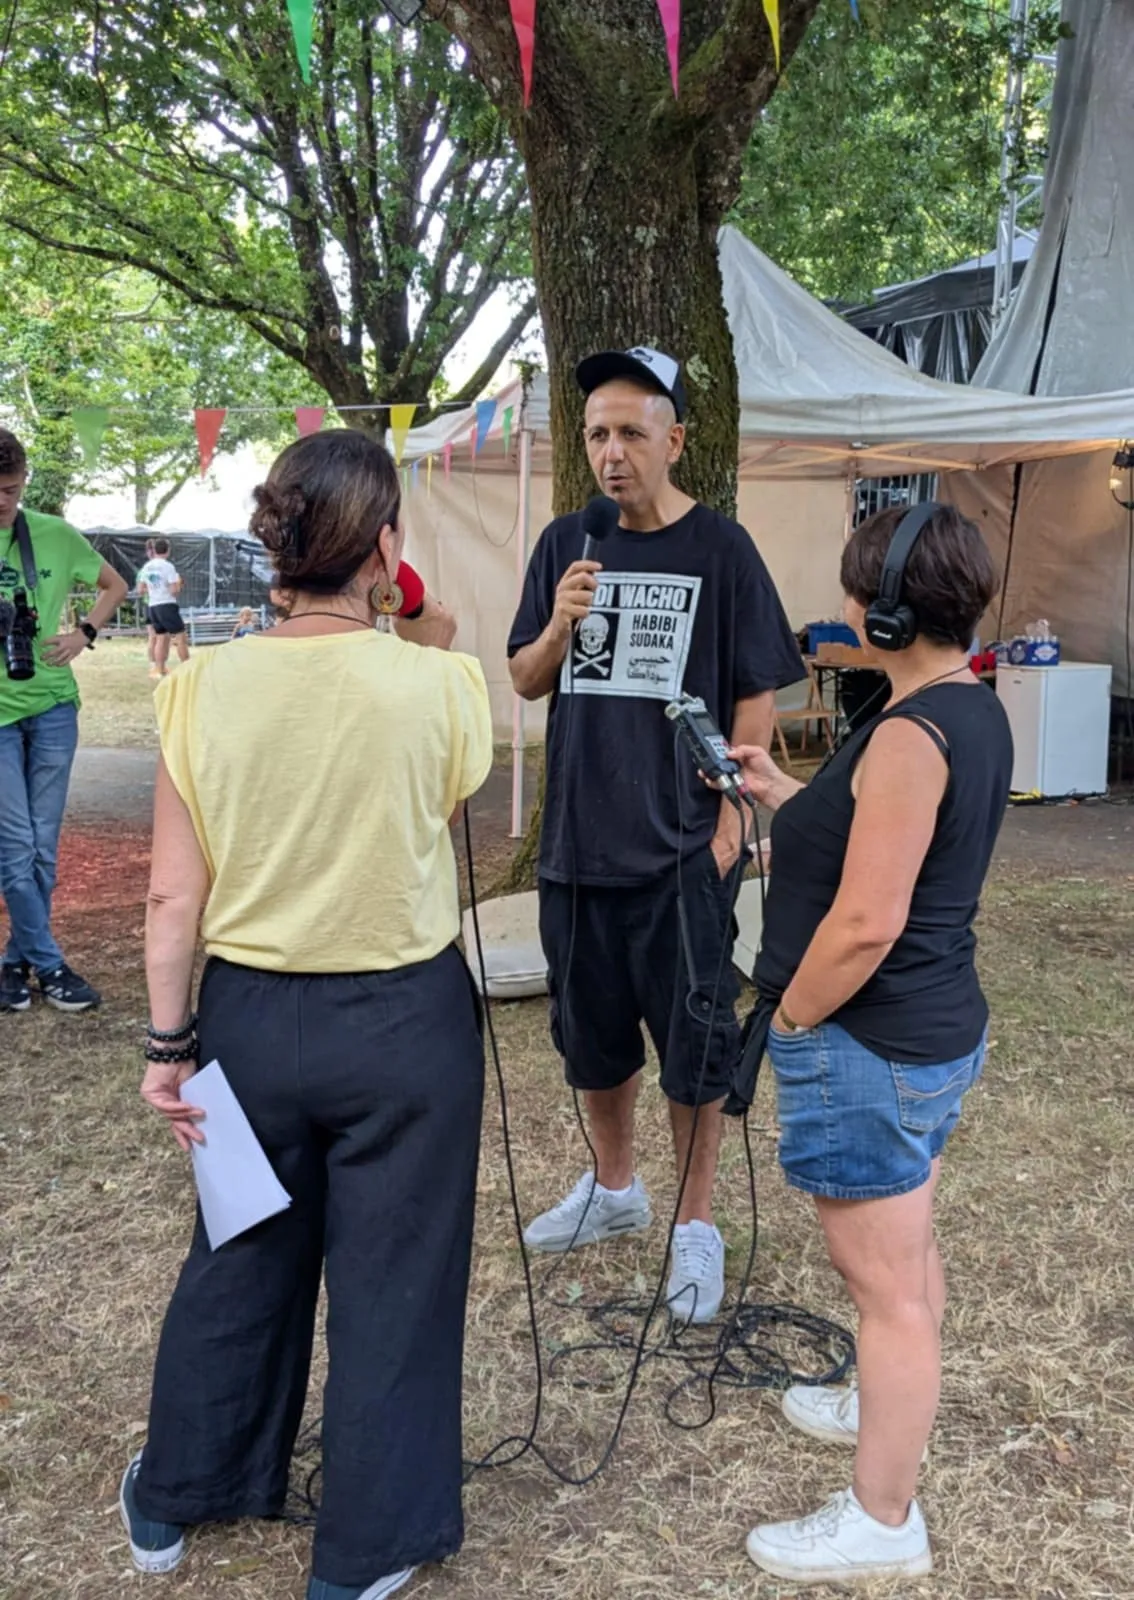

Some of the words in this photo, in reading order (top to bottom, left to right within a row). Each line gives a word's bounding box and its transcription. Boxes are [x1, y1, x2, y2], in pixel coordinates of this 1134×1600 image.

[594, 584, 615, 607] DI
[619, 584, 687, 611] WACHO
[632, 614, 678, 633] HABIBI
[629, 632, 674, 650] SUDAKA
